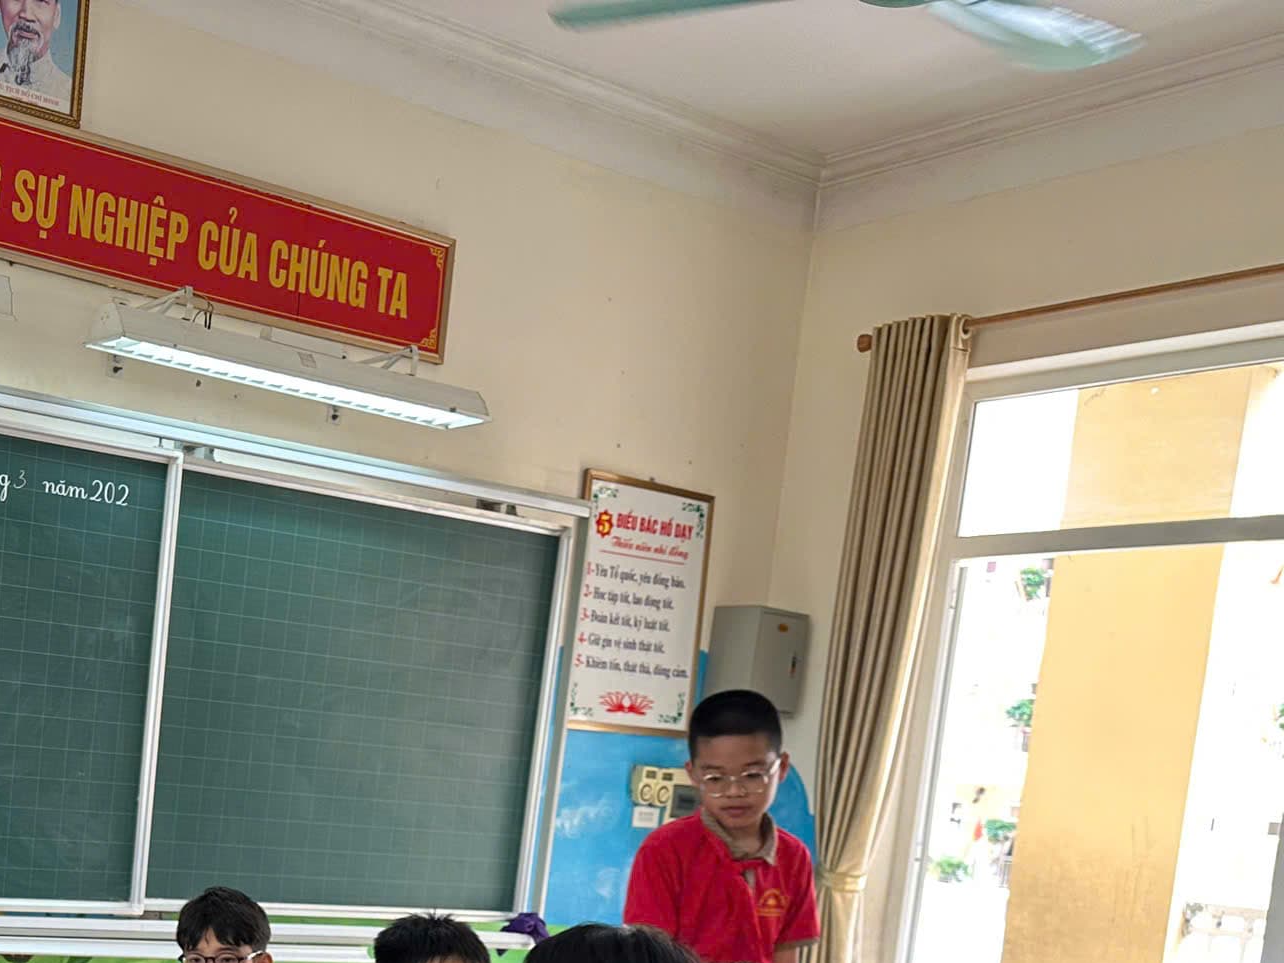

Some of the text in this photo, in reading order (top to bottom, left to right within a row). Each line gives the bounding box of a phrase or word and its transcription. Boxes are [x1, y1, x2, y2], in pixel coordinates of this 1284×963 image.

[12, 170, 64, 238] SỰ
[68, 185, 189, 266] NGHIỆP
[198, 208, 258, 280] CỦA
[269, 239, 368, 308] CHÚNG
[378, 267, 408, 319] TA
[639, 514, 658, 534] BÁC
